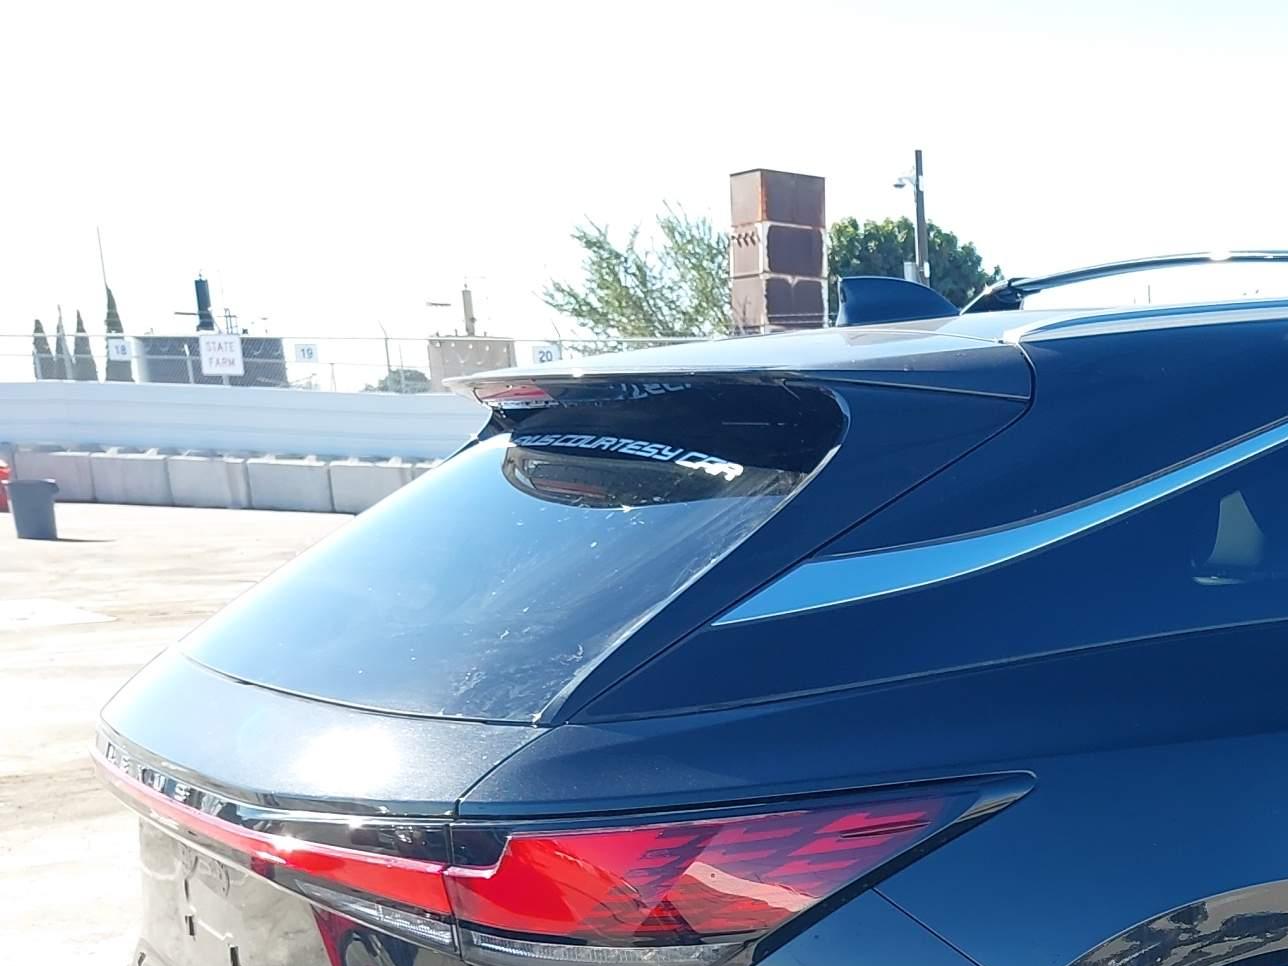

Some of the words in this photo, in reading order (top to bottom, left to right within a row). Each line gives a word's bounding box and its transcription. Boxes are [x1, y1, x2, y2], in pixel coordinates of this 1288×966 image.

[114, 344, 128, 355] 18
[205, 341, 235, 353] STATE
[301, 347, 313, 359] 19
[539, 350, 553, 363] 20
[208, 357, 236, 369] FARM
[553, 434, 683, 461] COURTESY
[675, 451, 744, 481] CAR
